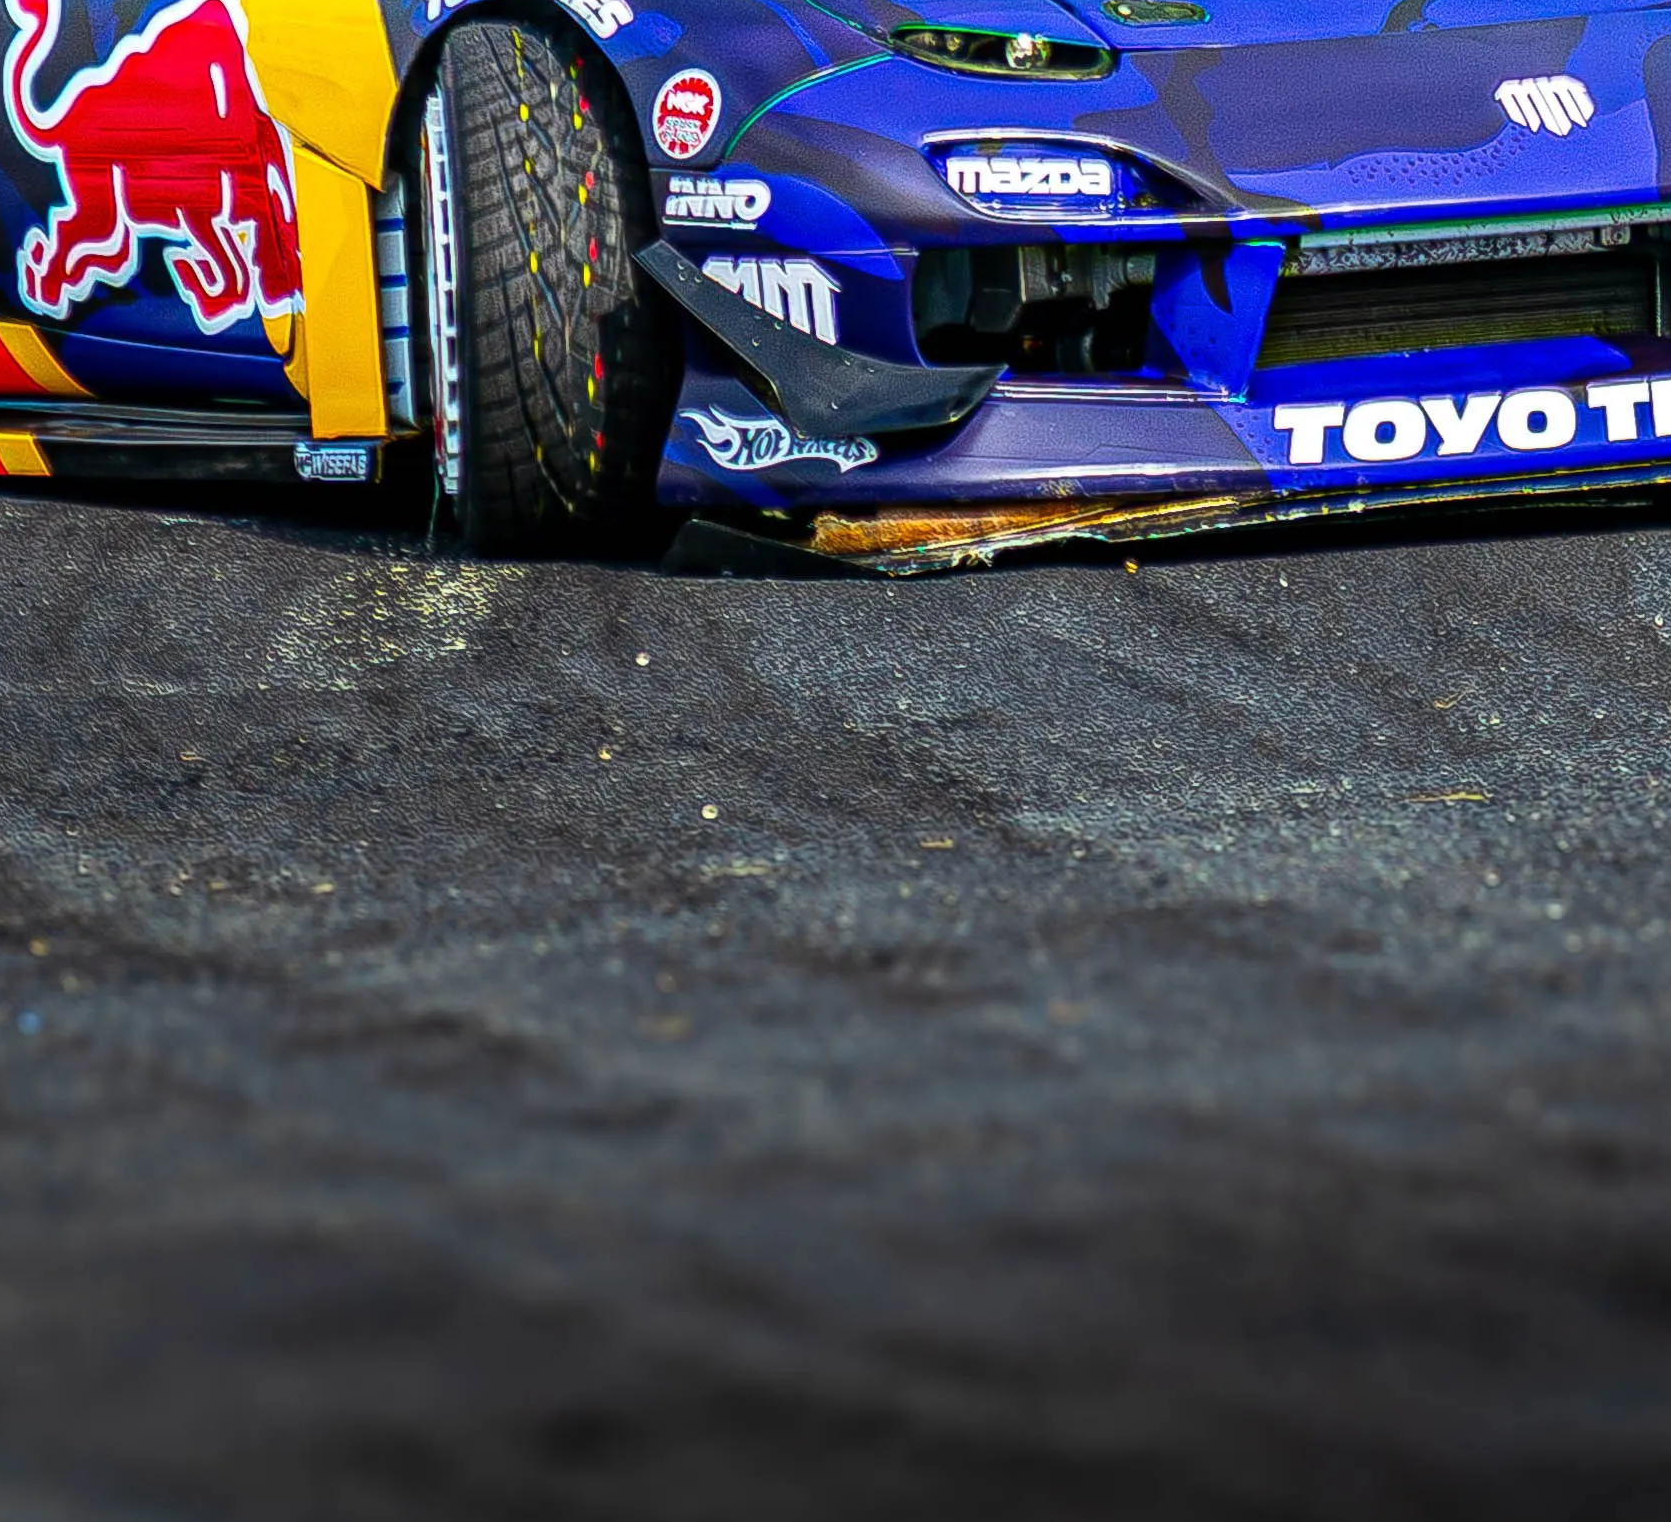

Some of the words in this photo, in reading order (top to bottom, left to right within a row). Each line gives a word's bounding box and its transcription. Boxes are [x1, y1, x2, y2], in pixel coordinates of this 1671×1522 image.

[666, 90, 710, 115] NGK
[946, 157, 1114, 196] mazda
[1273, 388, 1578, 466] TOYO
